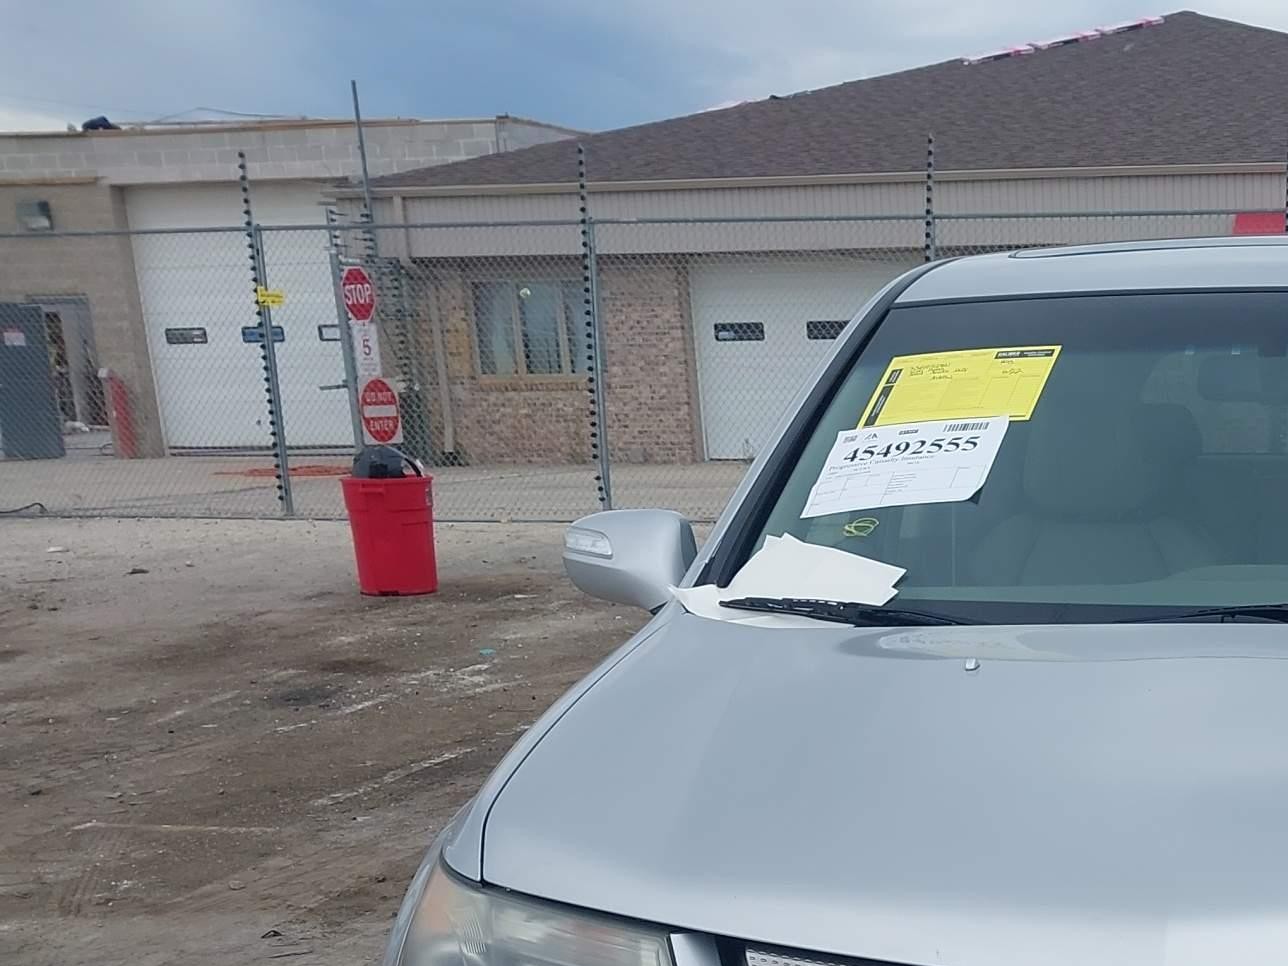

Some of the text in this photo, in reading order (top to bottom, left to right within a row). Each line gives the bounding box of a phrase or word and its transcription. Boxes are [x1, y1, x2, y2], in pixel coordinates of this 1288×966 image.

[344, 283, 371, 304] STOP
[362, 338, 371, 356] 5
[370, 420, 394, 431] ENTER
[843, 436, 981, 462] 45492555
